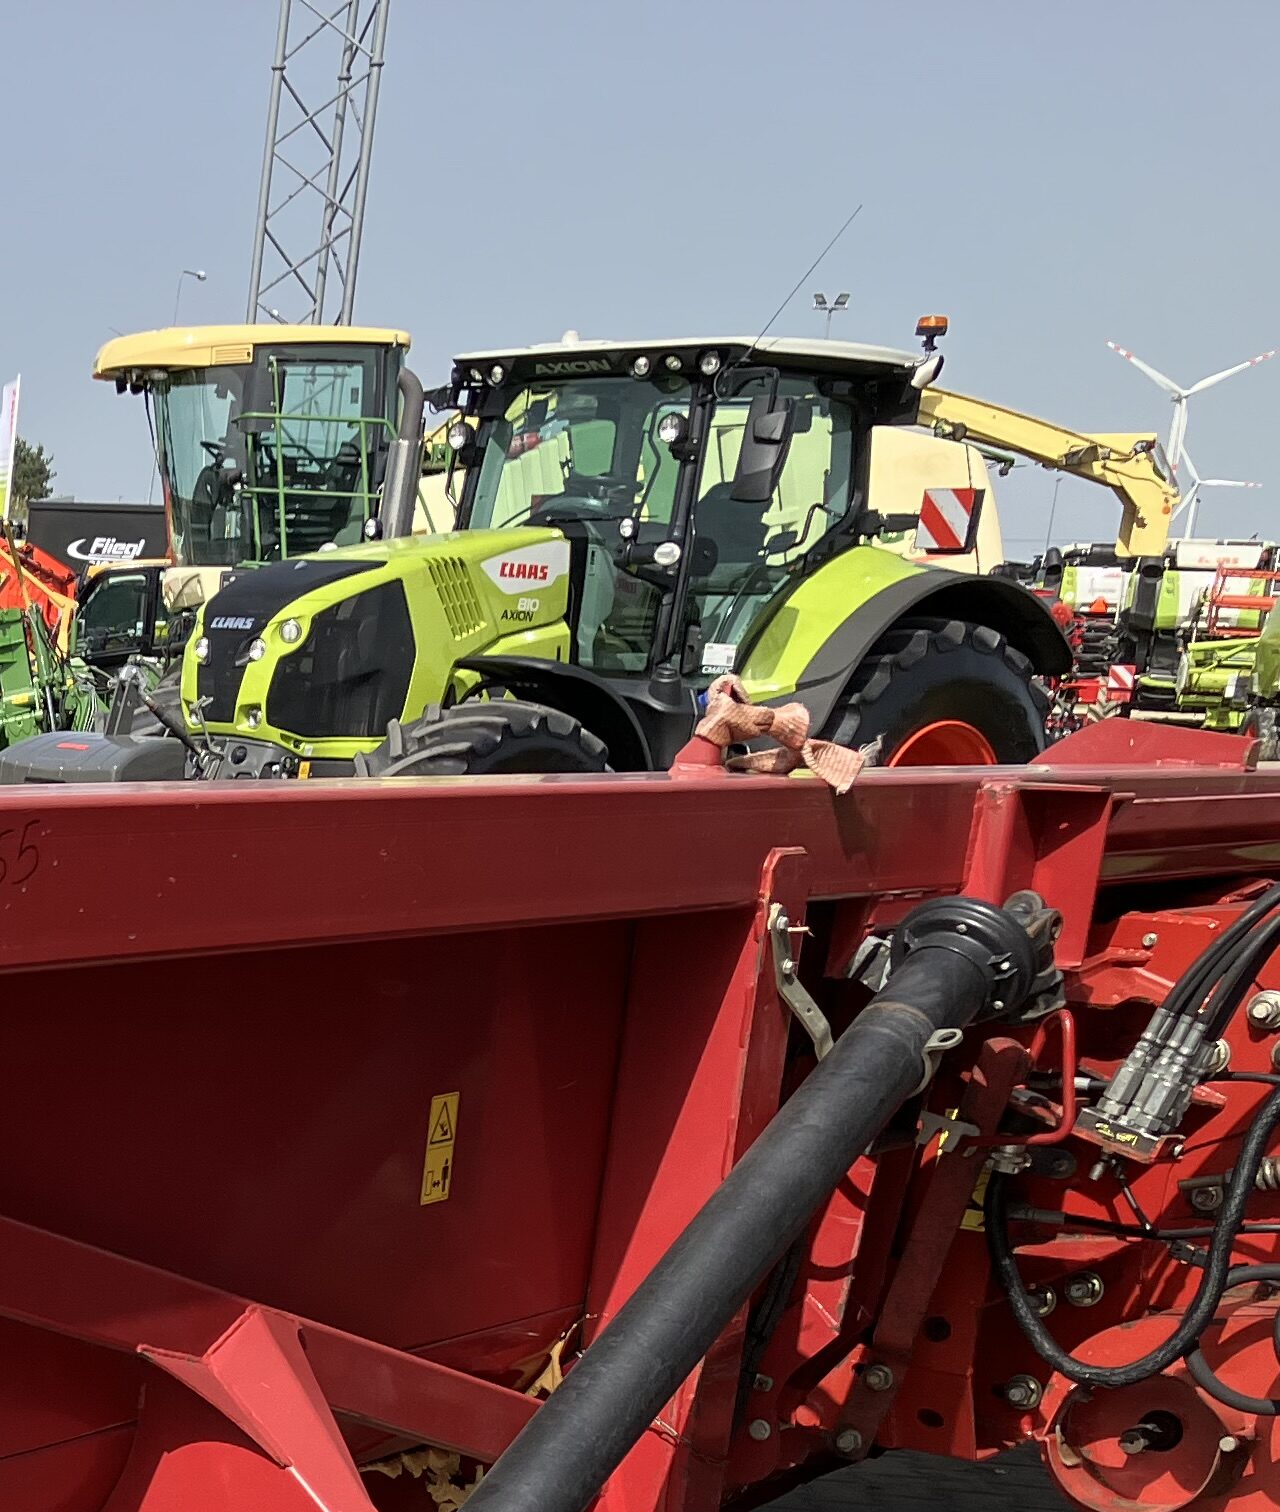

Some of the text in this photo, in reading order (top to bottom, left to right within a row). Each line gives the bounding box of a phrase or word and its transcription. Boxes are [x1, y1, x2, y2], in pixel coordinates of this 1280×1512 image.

[535, 359, 611, 375] AXION
[90, 537, 146, 560] Fliegl
[500, 562, 549, 581] CLAAS
[210, 616, 255, 630] CLAAS
[501, 609, 534, 622] AXION
